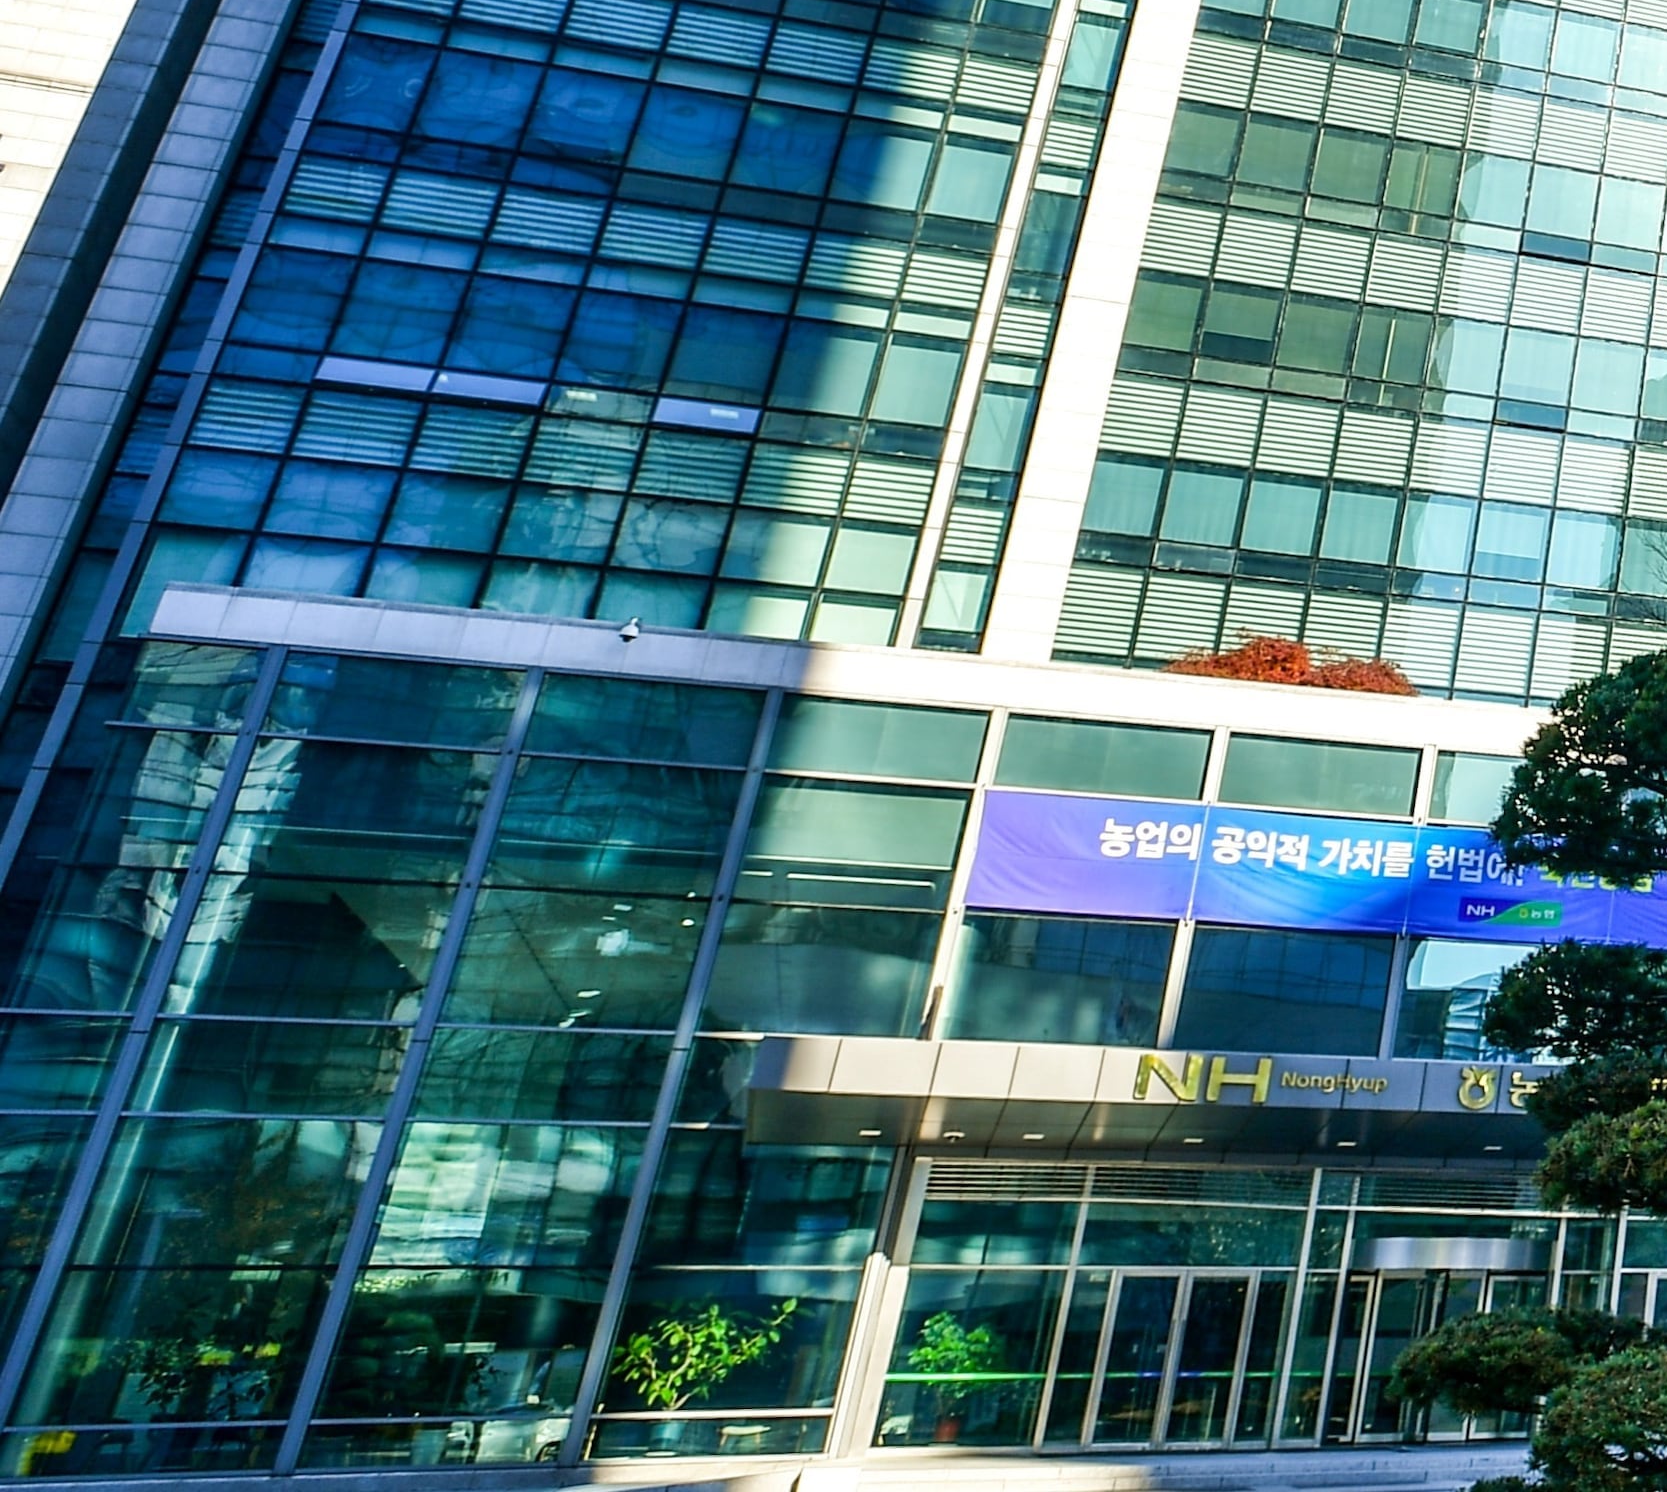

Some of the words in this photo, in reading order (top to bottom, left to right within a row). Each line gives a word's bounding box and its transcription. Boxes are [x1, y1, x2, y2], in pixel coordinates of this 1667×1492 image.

[1099, 817, 1201, 861] 농업의
[1211, 825, 1309, 875] 공익적
[1317, 837, 1415, 879] 가치를
[1466, 904, 1496, 917] NH
[1133, 1053, 1273, 1105] NH
[1280, 1070, 1389, 1095] NongHyup
